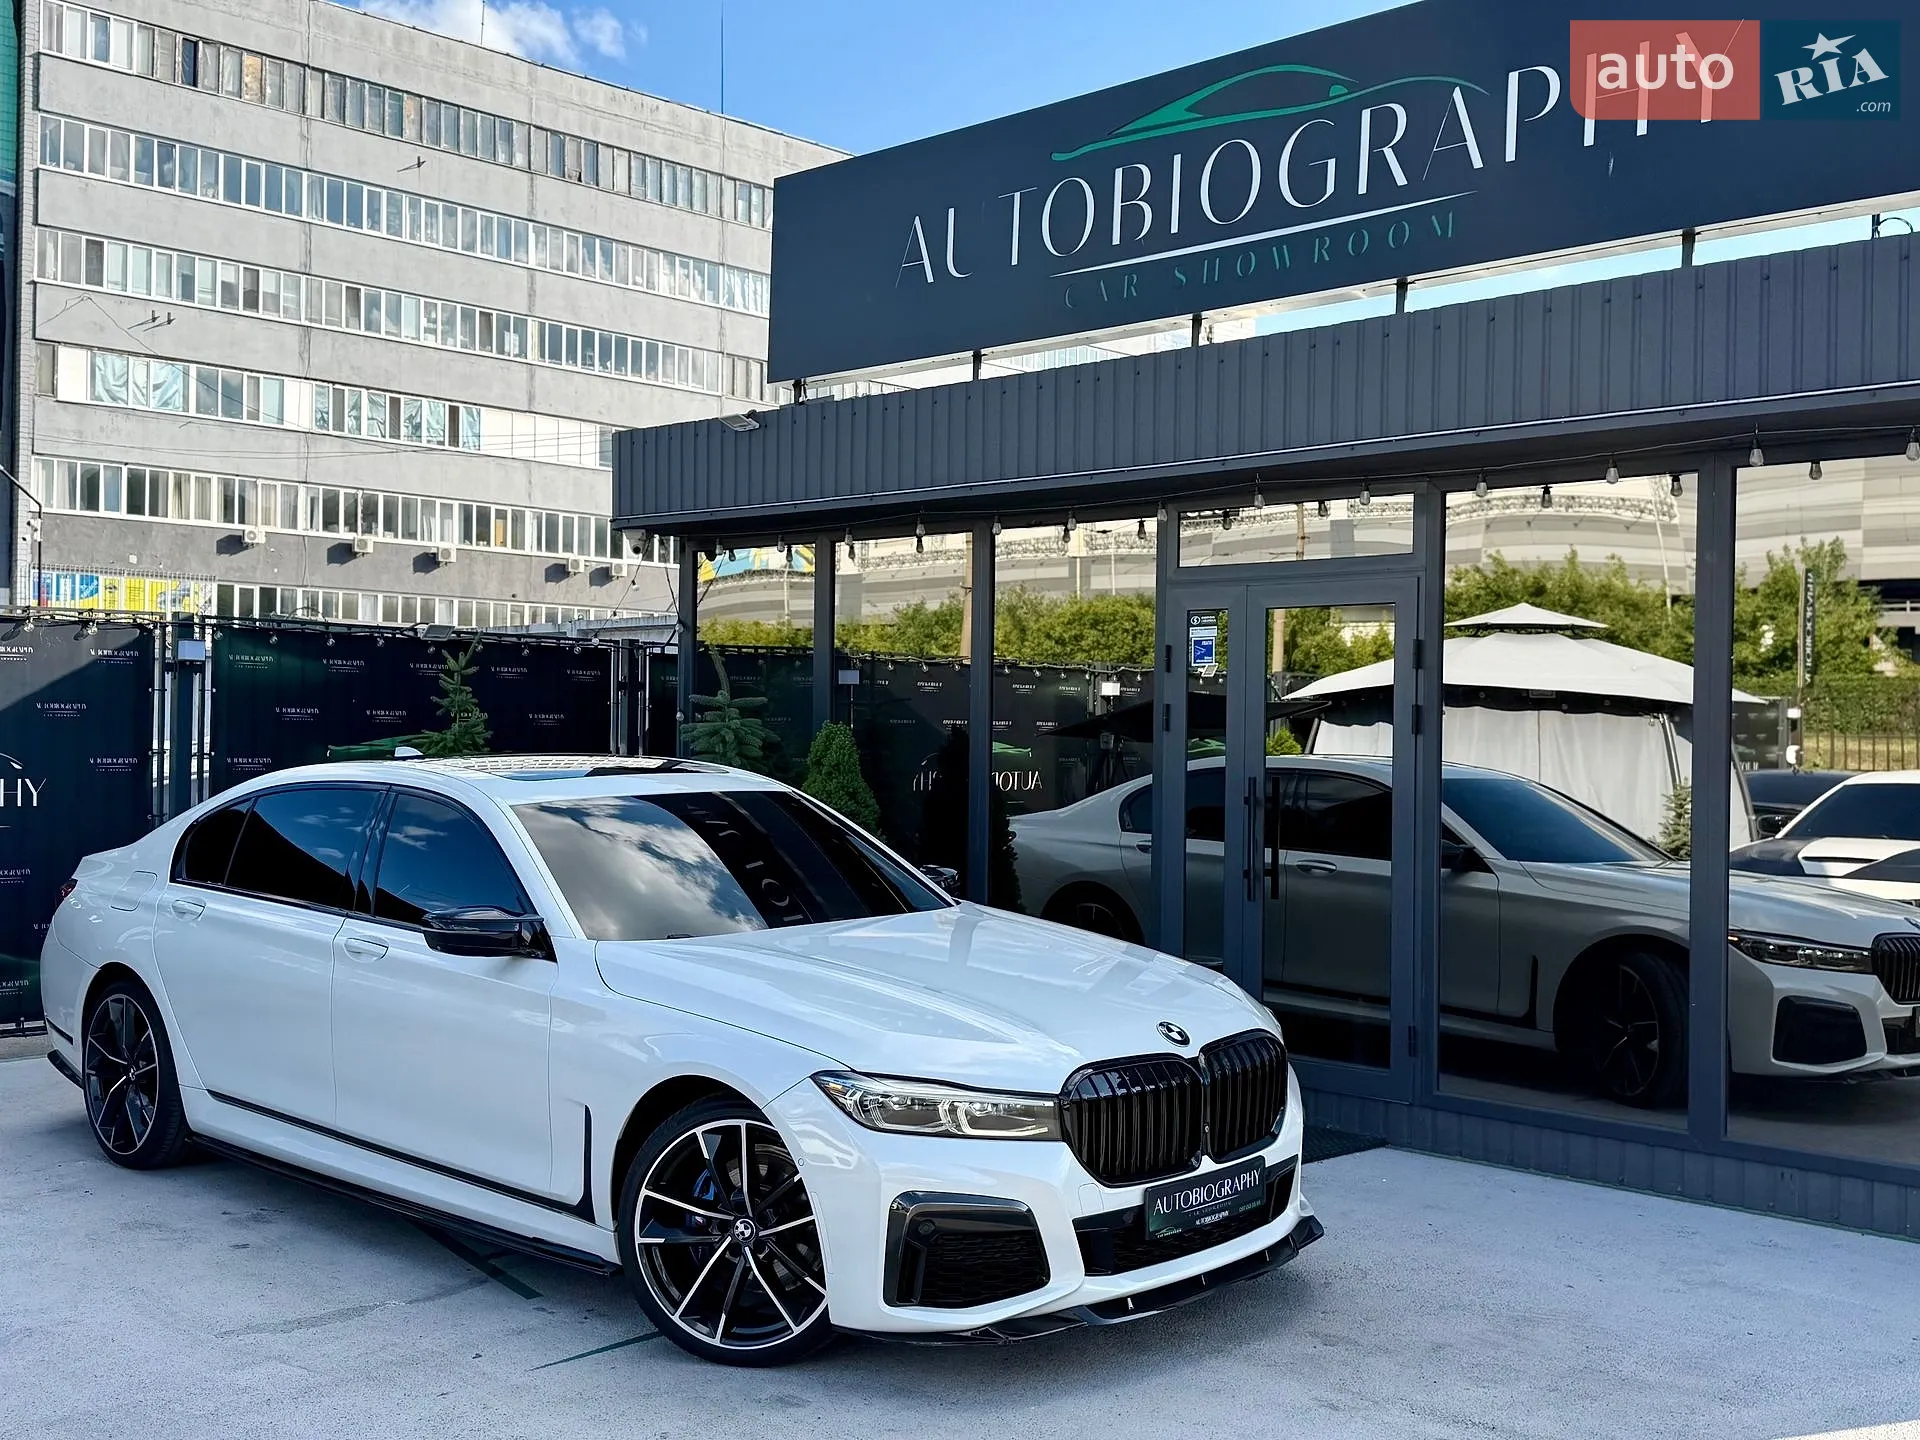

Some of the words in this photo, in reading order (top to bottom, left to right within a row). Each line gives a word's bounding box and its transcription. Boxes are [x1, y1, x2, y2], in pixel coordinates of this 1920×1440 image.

[895, 18, 1744, 287] AUTOBIOGRAPHY
[1064, 273, 1139, 309] CAR
[1173, 210, 1455, 287] SHOWROOM
[1153, 1168, 1261, 1216] AUTOBIOGRAPHY
